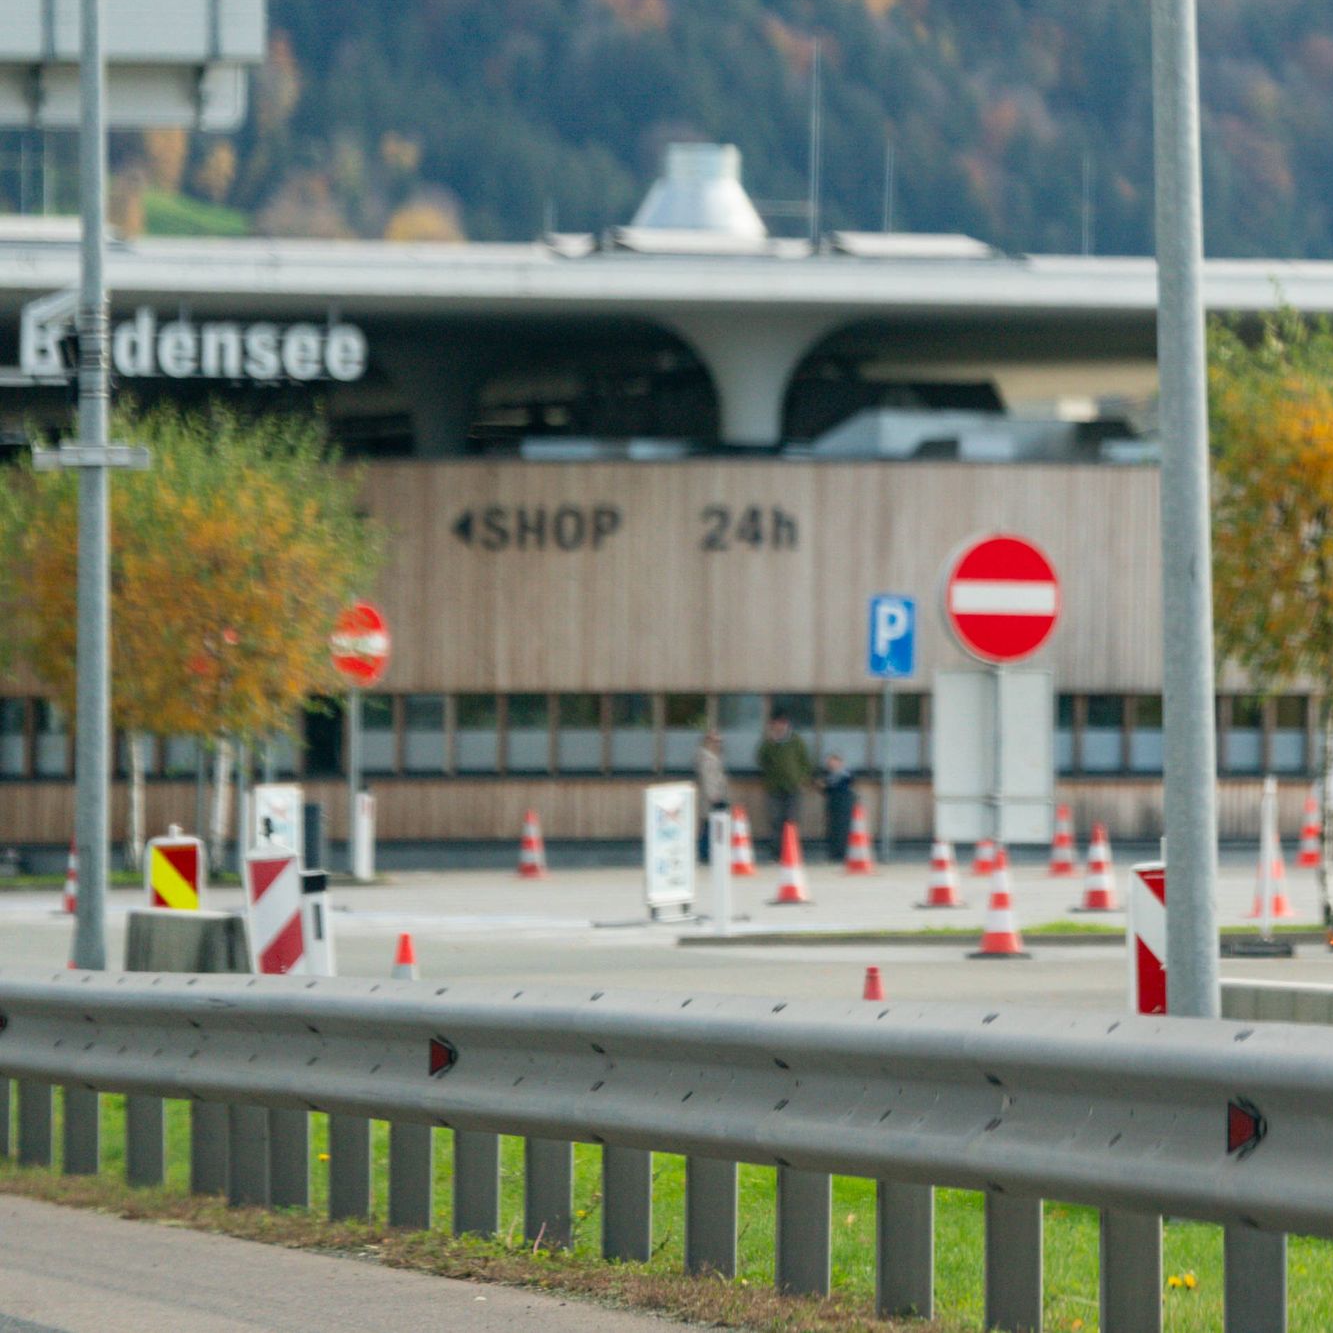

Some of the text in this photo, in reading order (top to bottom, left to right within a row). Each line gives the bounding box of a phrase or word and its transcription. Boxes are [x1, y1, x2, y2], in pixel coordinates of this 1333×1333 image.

[20, 306, 368, 382] Bdensee
[480, 502, 798, 552] SHOP 24h
[876, 602, 908, 657] P
